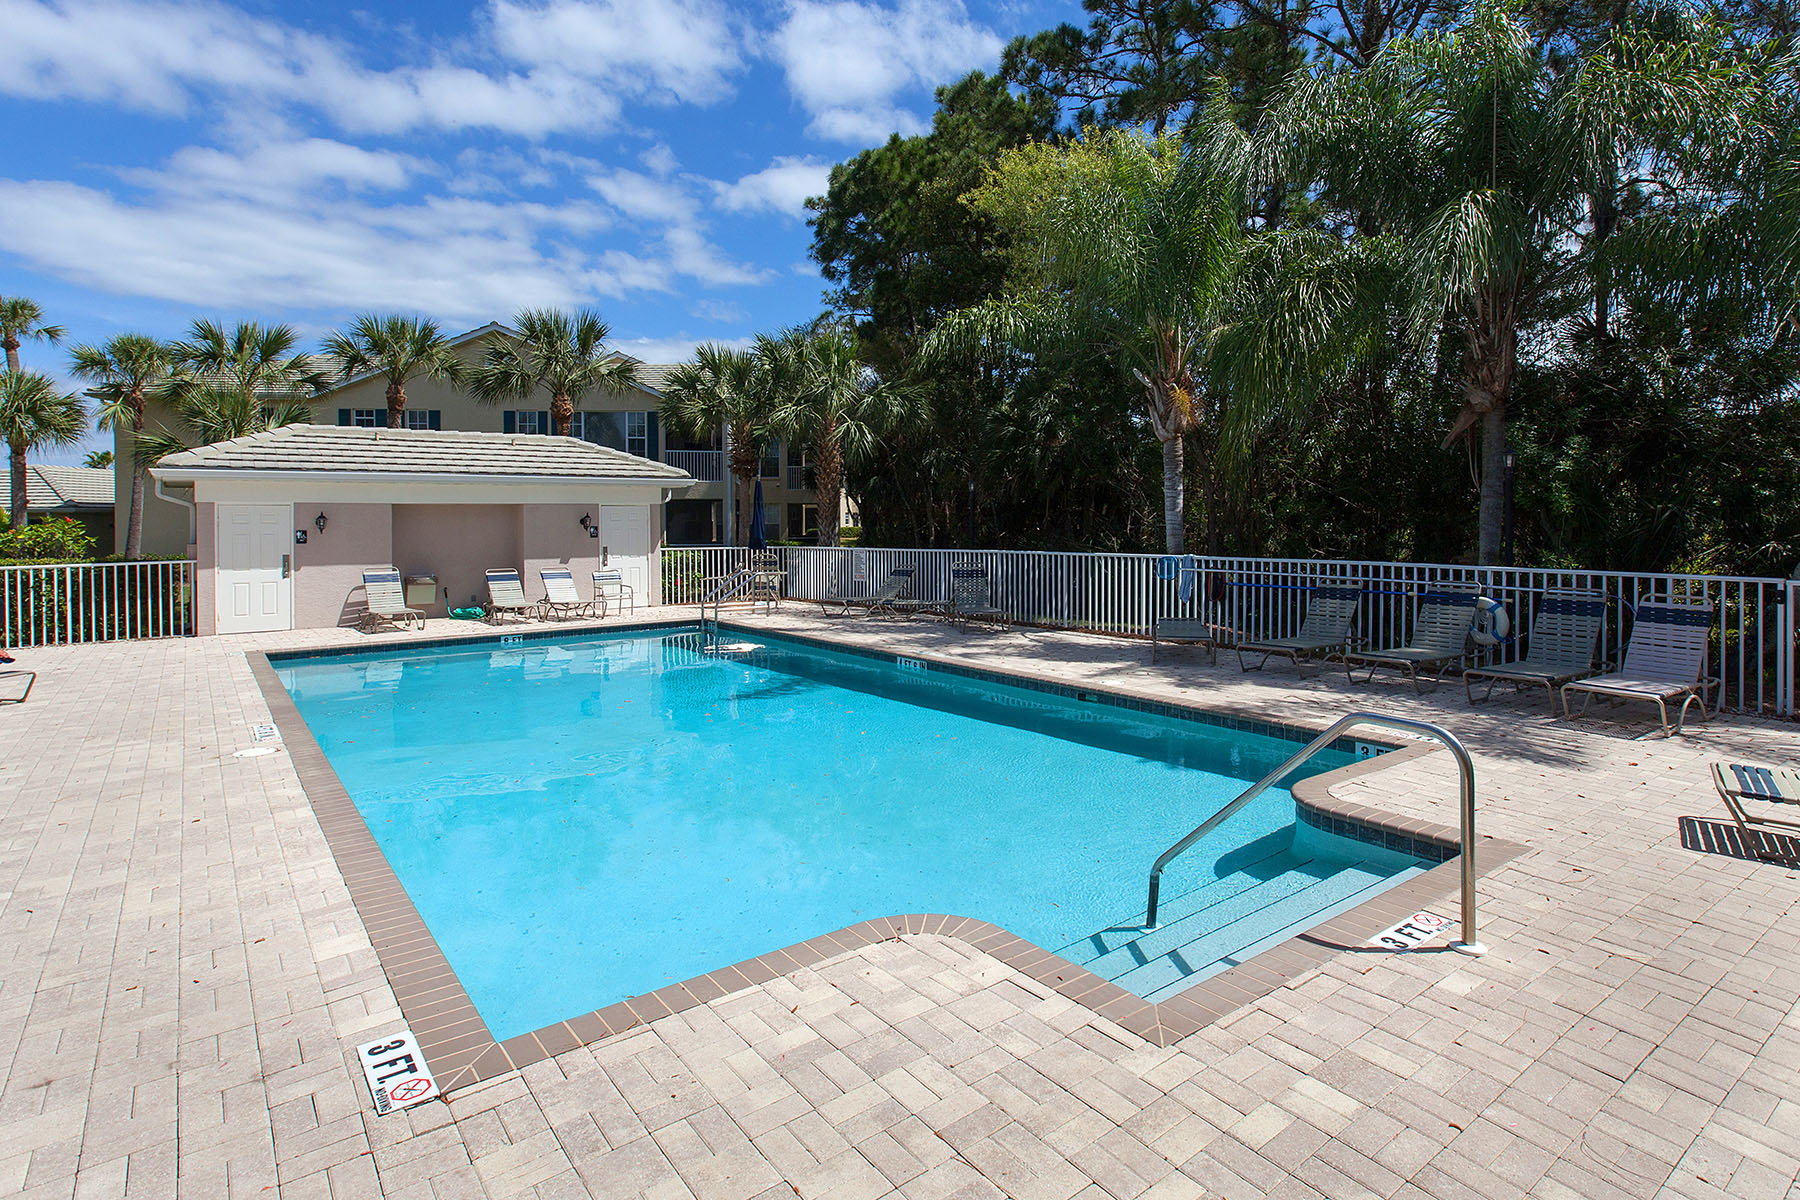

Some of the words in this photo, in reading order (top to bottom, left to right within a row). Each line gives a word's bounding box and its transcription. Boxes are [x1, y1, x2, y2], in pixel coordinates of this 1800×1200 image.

[1394, 922, 1434, 941] FT.
[1380, 936, 1409, 949] 3
[367, 1039, 406, 1056] 3
[372, 1053, 418, 1084] FT.
